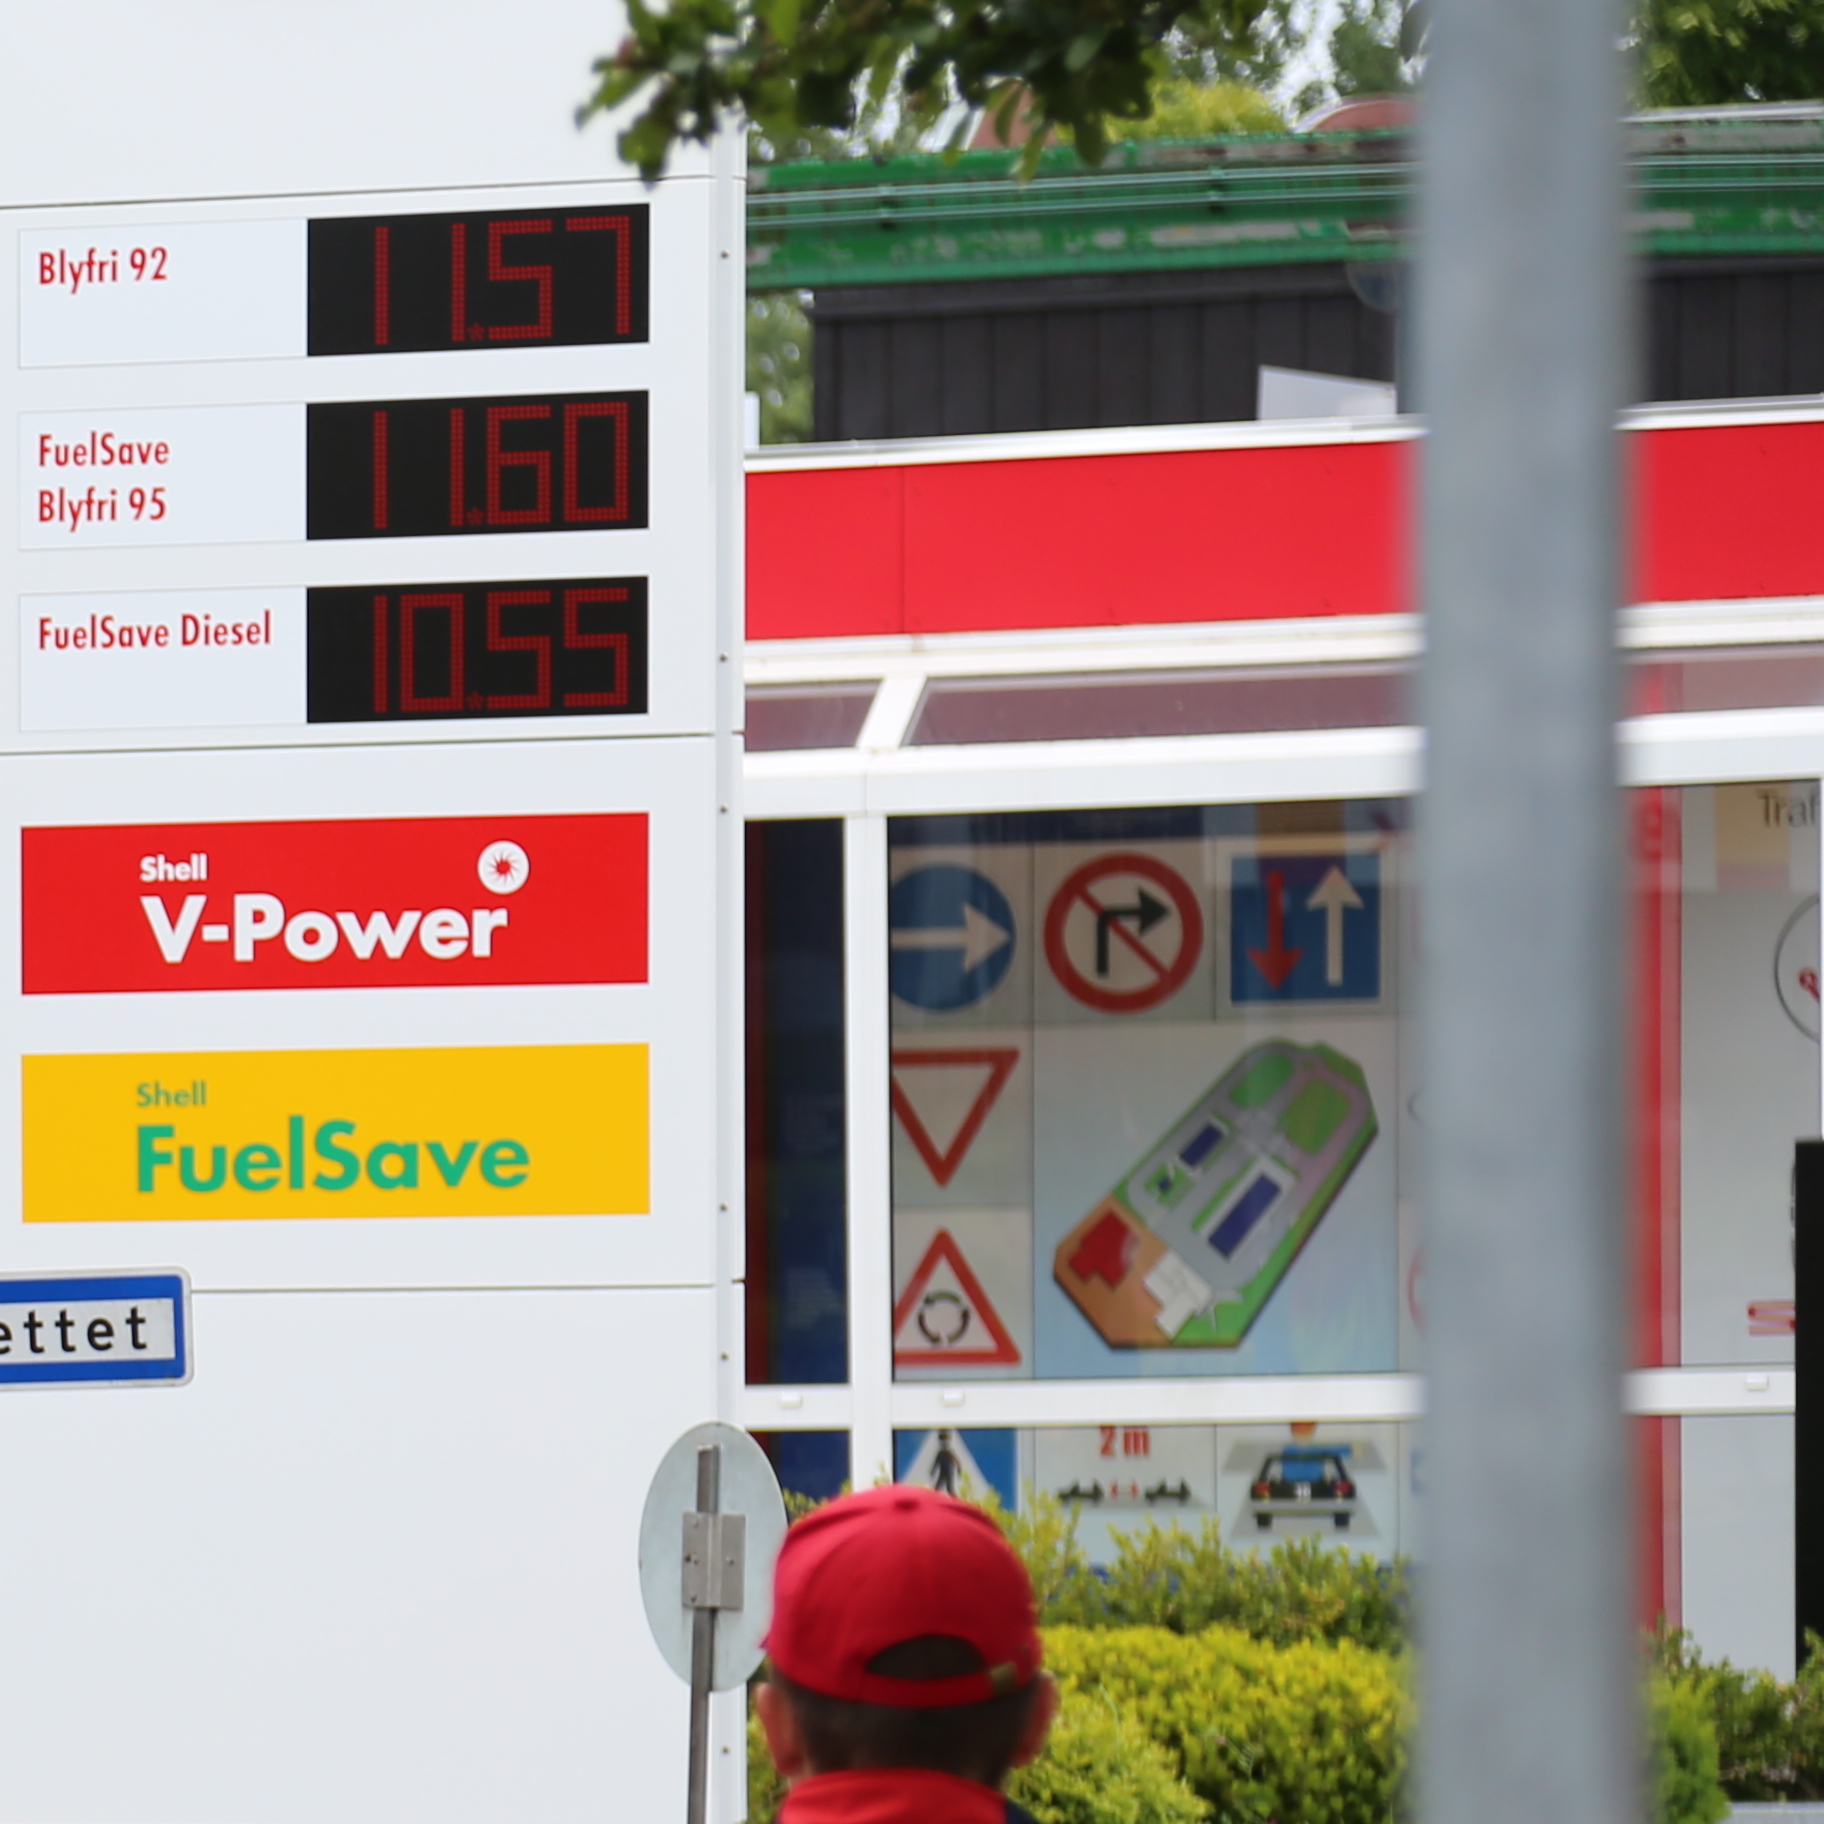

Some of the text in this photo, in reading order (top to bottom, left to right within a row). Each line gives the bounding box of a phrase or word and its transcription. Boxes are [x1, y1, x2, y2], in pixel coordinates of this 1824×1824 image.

[38, 247, 169, 293] Blyfri 92
[38, 432, 170, 469] FuelSave
[38, 488, 167, 532] Blyfri 95
[38, 611, 272, 651] FuelSave Diesel
[140, 853, 208, 883] Shell
[141, 893, 509, 964] V-Power
[136, 1081, 207, 1109] Shell
[137, 1117, 530, 1194] FuelSave
